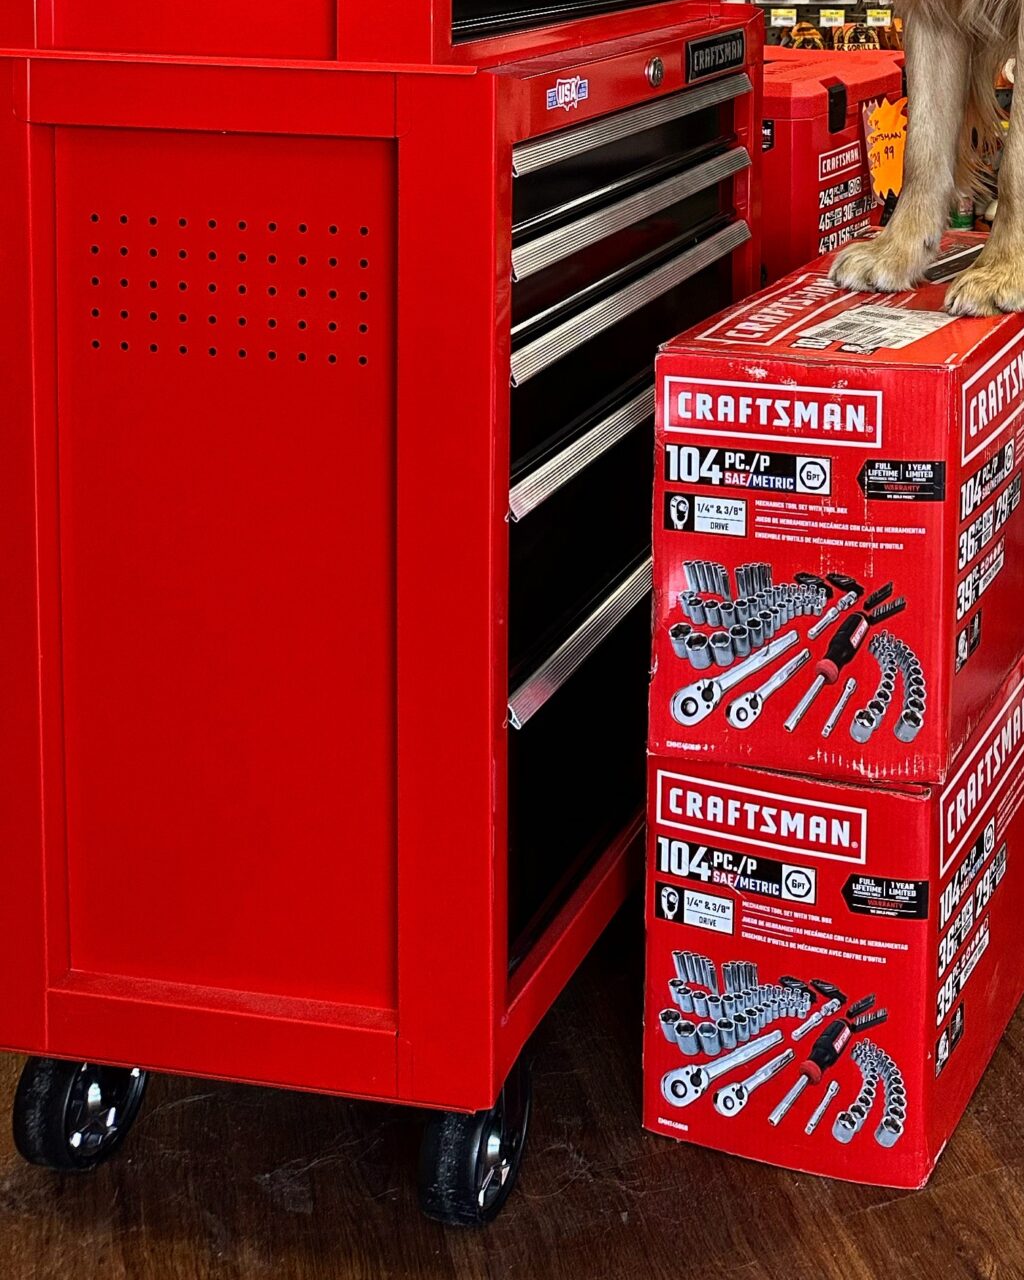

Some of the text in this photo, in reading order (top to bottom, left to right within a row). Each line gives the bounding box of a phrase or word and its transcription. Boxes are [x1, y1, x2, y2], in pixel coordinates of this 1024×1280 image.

[694, 39, 743, 71] CRAFTSMAN
[847, 43, 880, 51] GORILLA
[558, 80, 577, 103] USA
[821, 147, 859, 174] CRAFTSMAN
[819, 189, 834, 209] 243
[725, 277, 839, 339] CRAFTSMAN
[677, 391, 866, 433] CRAFTSMAN
[666, 444, 771, 485] 104 PC./P
[868, 469, 899, 478] LIFETIME
[875, 462, 892, 470] FULL
[905, 470, 934, 478] LIMITED
[912, 463, 932, 471] YEAR
[724, 470, 794, 491] SAE/METRIC
[883, 484, 920, 492] WARRANTY
[961, 470, 982, 520] 104
[715, 505, 723, 515] &
[710, 521, 730, 532] DRIVE
[959, 496, 1008, 570] 36 29
[957, 579, 973, 621] 39
[669, 787, 851, 848] CRAFTSMAN
[657, 835, 758, 882] 104 PC./P
[712, 870, 780, 896] SAE/METRIC
[791, 878, 806, 891] 6PT
[852, 882, 883, 893] LIFETIME
[859, 877, 876, 886] FULL
[896, 882, 915, 890] YEAR
[888, 888, 917, 897] LIMITED
[939, 871, 960, 930] 104
[704, 900, 711, 910] &
[699, 916, 717, 928] DRIVE
[938, 869, 991, 978] 36 29
[936, 973, 953, 1027] 39
